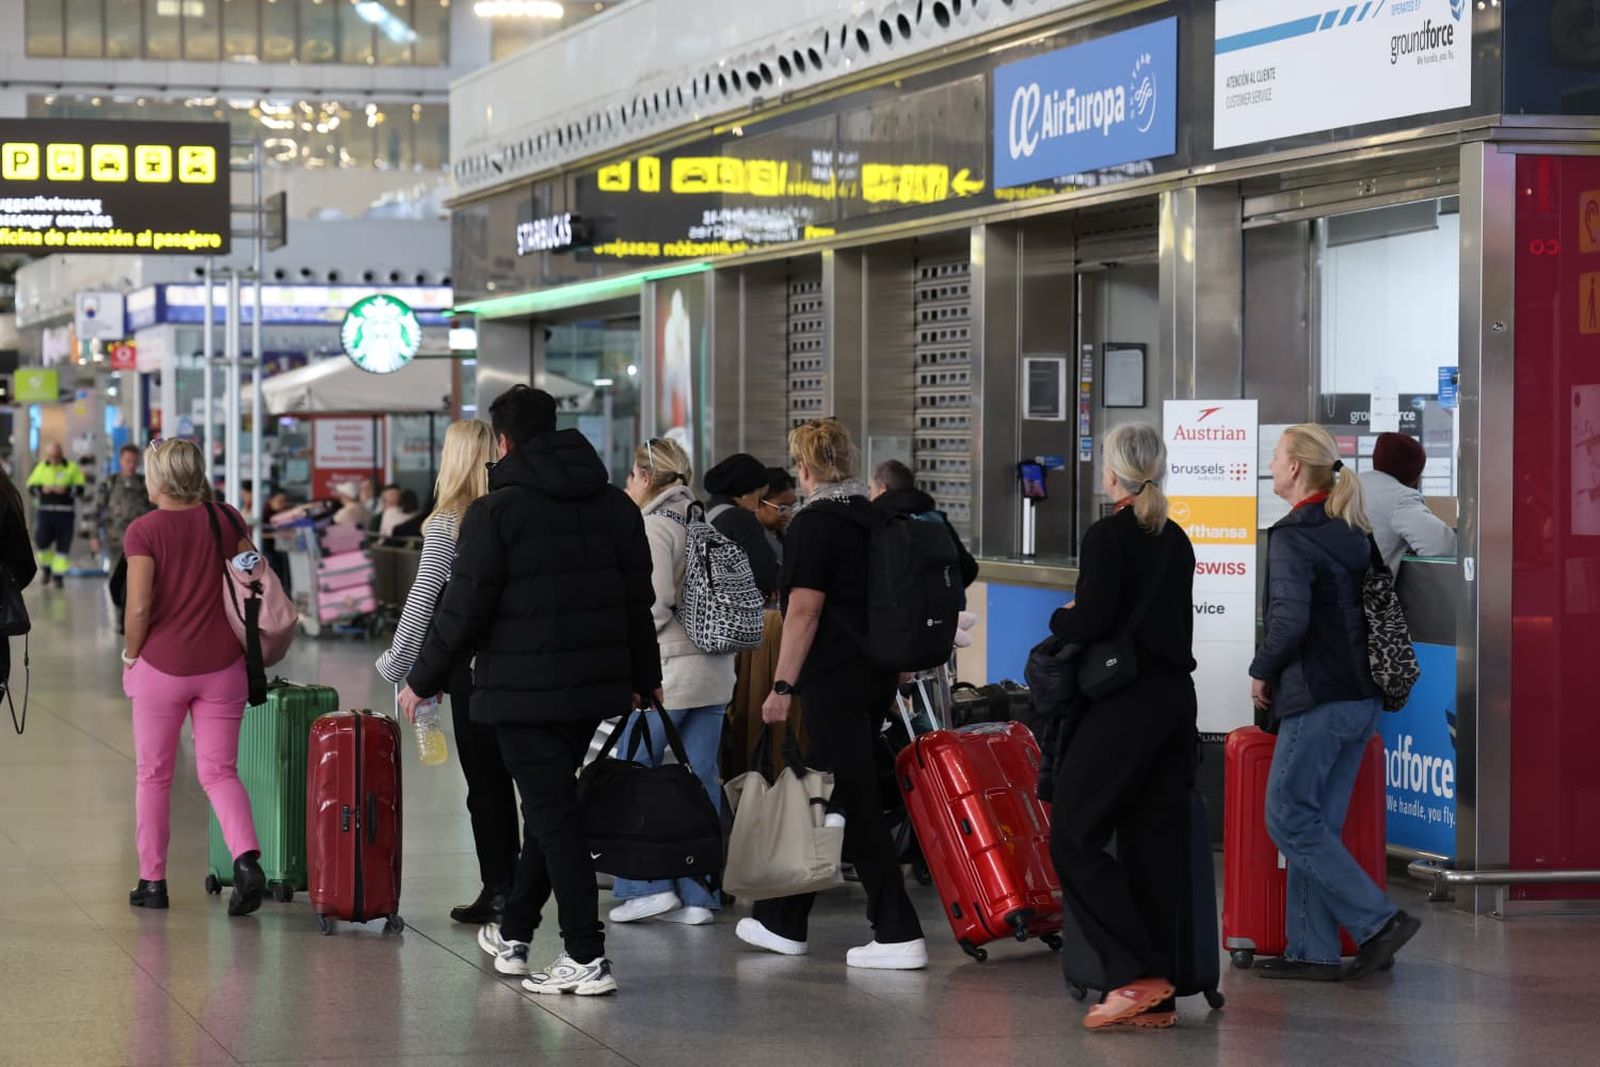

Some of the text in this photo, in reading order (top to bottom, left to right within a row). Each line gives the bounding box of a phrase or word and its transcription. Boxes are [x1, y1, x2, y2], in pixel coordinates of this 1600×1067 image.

[1390, 19, 1454, 65] groundforce
[1256, 66, 1276, 83] CLIENTE
[1041, 84, 1125, 140] AirEuropa
[44, 228, 65, 246] de
[66, 229, 134, 246] atención
[136, 229, 152, 246] al
[153, 230, 221, 249] pasajero
[1173, 424, 1246, 441] Austrian
[1171, 463, 1225, 475] brussels
[1186, 523, 1248, 538] fthansa
[1195, 562, 1246, 575] SWISS
[1386, 795, 1456, 828] We handle, you fly.
